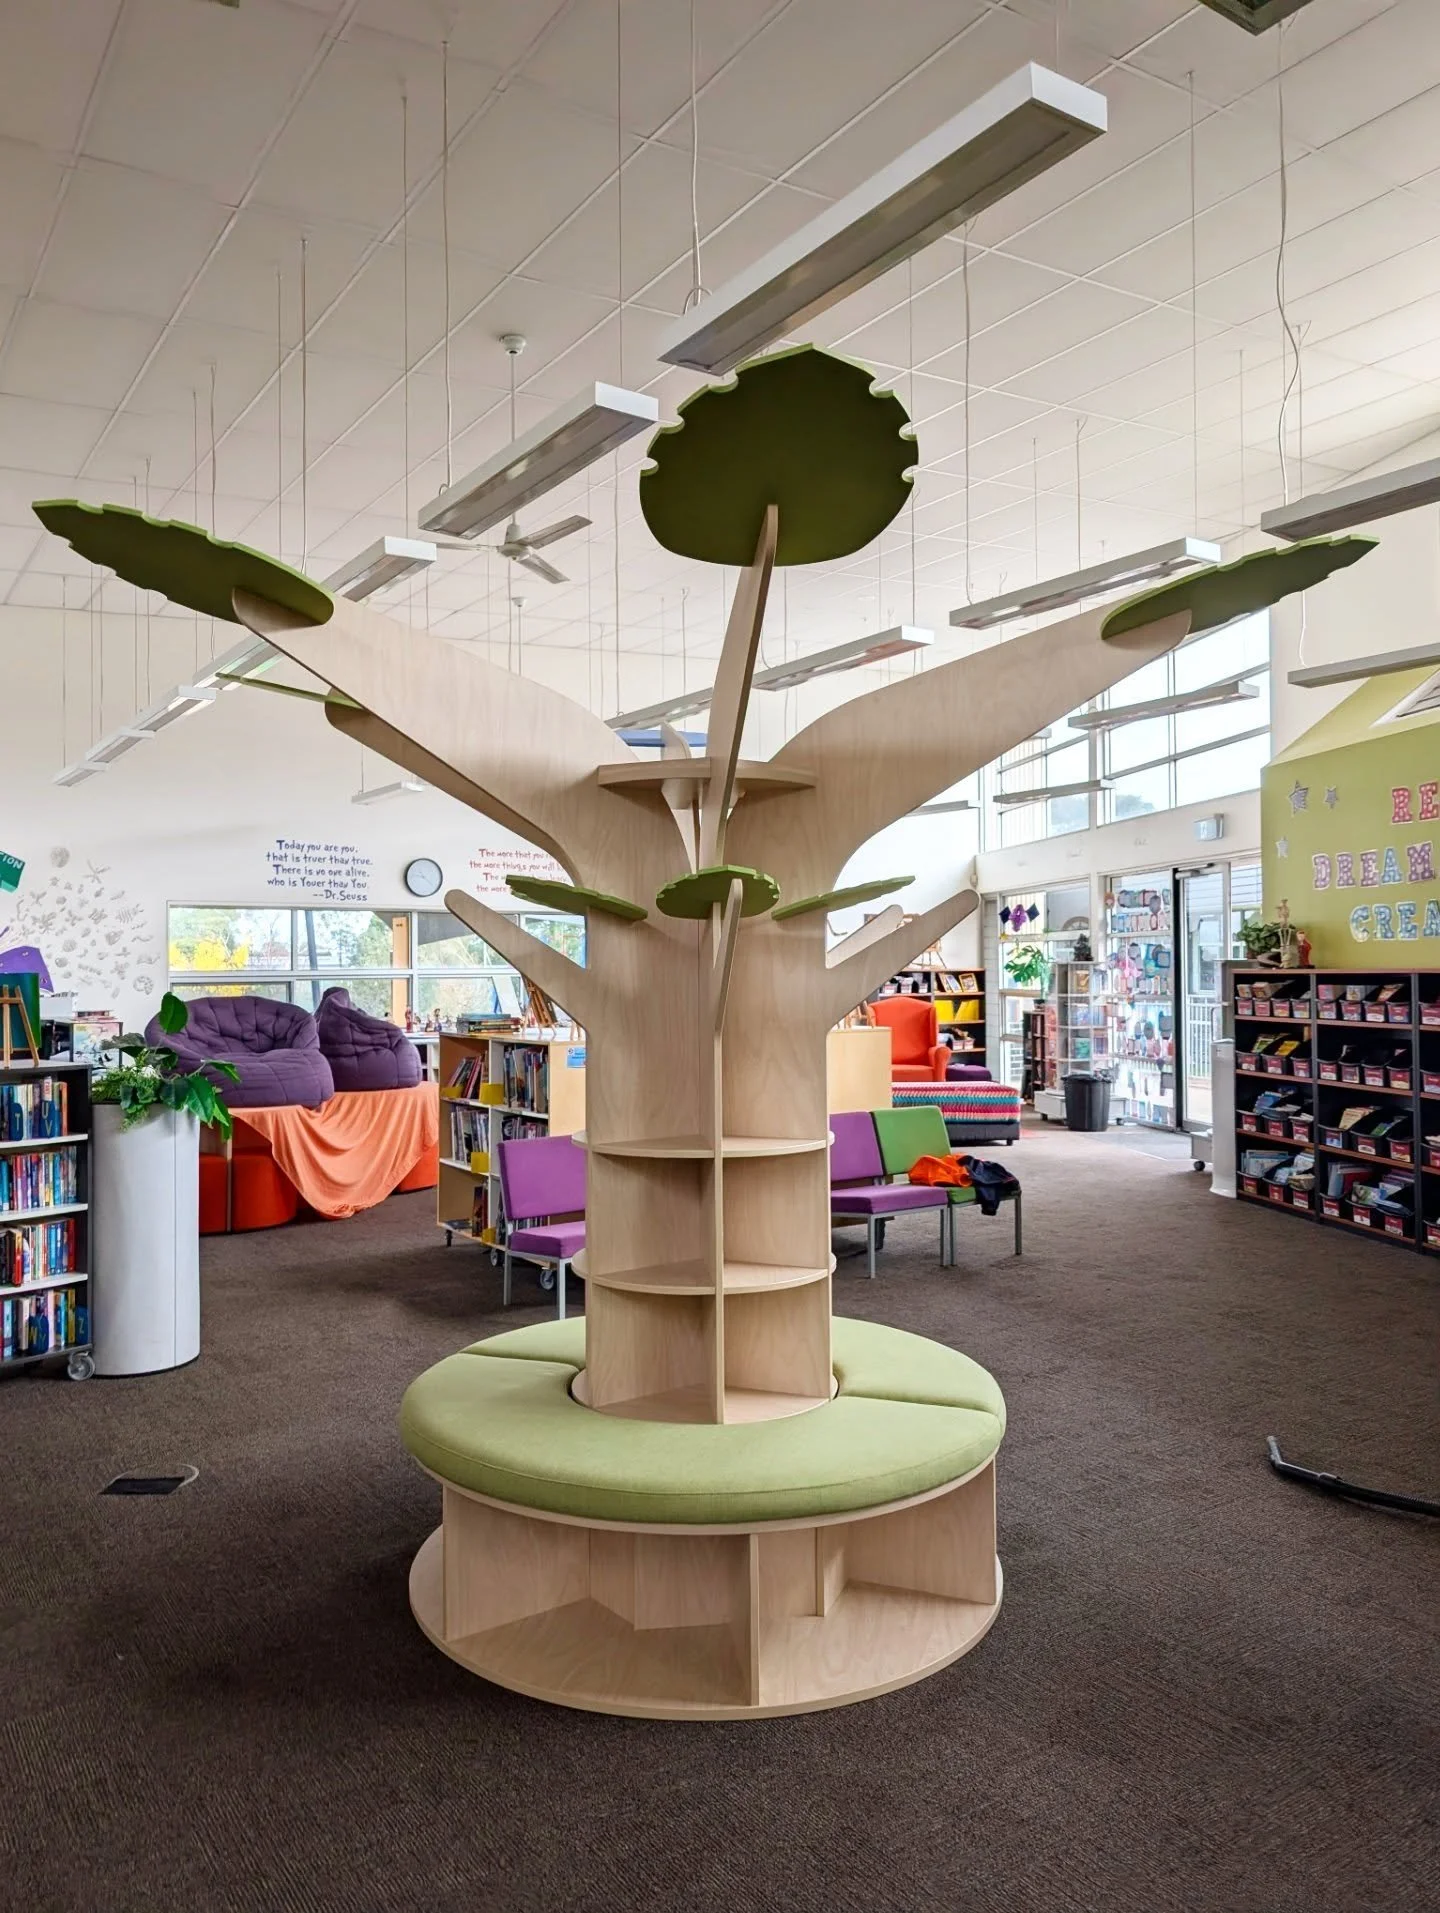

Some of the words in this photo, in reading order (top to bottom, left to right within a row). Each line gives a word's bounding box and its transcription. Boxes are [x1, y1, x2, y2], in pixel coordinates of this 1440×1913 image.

[276, 840, 305, 852] Today
[307, 844, 320, 853] you
[266, 852, 288, 861] that
[292, 853, 300, 862] is
[303, 854, 327, 863] truer
[329, 855, 349, 865] than
[479, 848, 494, 857] The
[515, 850, 531, 858] that
[273, 864, 301, 875] There
[305, 866, 313, 875] is
[469, 860, 481, 868] the
[502, 861, 527, 871] things
[1312, 841, 1436, 890] DREAM
[267, 877, 285, 886] who
[288, 878, 297, 887] is
[300, 877, 326, 888] Youer
[328, 879, 348, 888] than
[483, 873, 499, 881] The
